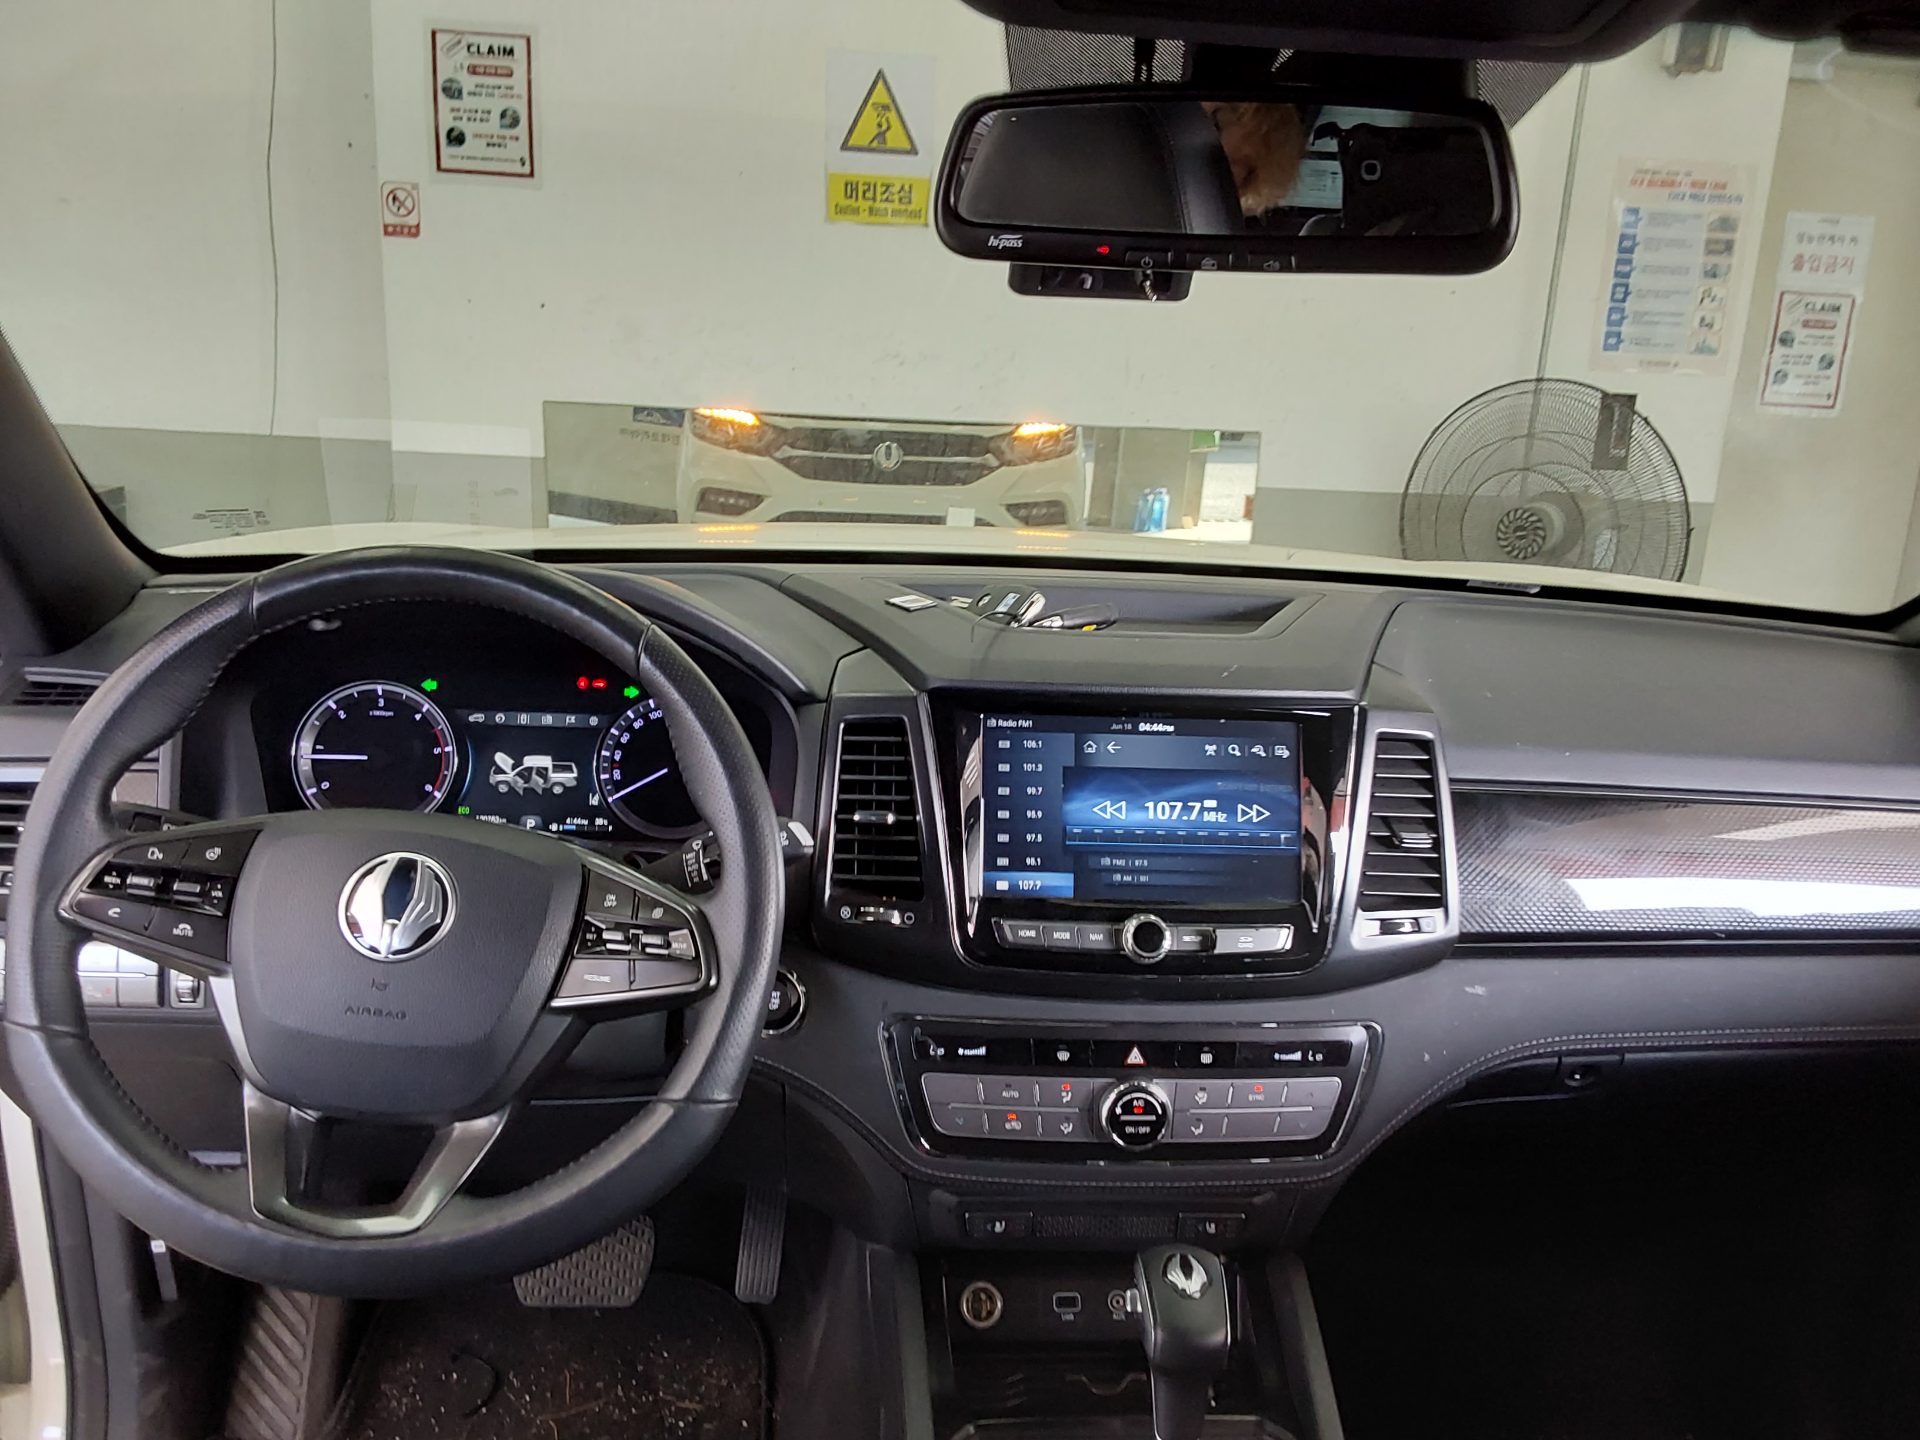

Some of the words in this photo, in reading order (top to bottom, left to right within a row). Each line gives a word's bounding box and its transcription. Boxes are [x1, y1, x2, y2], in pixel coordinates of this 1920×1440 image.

[467, 43, 515, 57] CLAIM
[843, 180, 913, 205] 머리조심
[988, 235, 1023, 250] hi-pass
[1792, 253, 1855, 275] 출입금지
[1804, 301, 1842, 313] CLAIM
[378, 698, 385, 707] 3
[337, 710, 347, 720] 2
[414, 712, 422, 721] 4
[648, 709, 663, 720] 100
[632, 718, 644, 730] 80
[997, 718, 1017, 728] Radio
[1018, 719, 1033, 728] FM1
[620, 732, 630, 744] 60
[1023, 739, 1042, 749] 106.1
[614, 749, 622, 762] 40
[612, 769, 621, 781] 20
[458, 806, 470, 815] ECO
[1144, 801, 1202, 821] 107.7
[1203, 811, 1228, 823] MHz
[526, 819, 536, 830] P
[1018, 880, 1042, 891] 107.7
[605, 893, 617, 901] ON
[603, 900, 618, 908] OFF
[172, 928, 194, 937] MUTE
[1018, 929, 1037, 938] HOME
[1053, 931, 1071, 940] MODE
[344, 1006, 407, 1020] AIRBAG
[1002, 1090, 1019, 1098] AUTO
